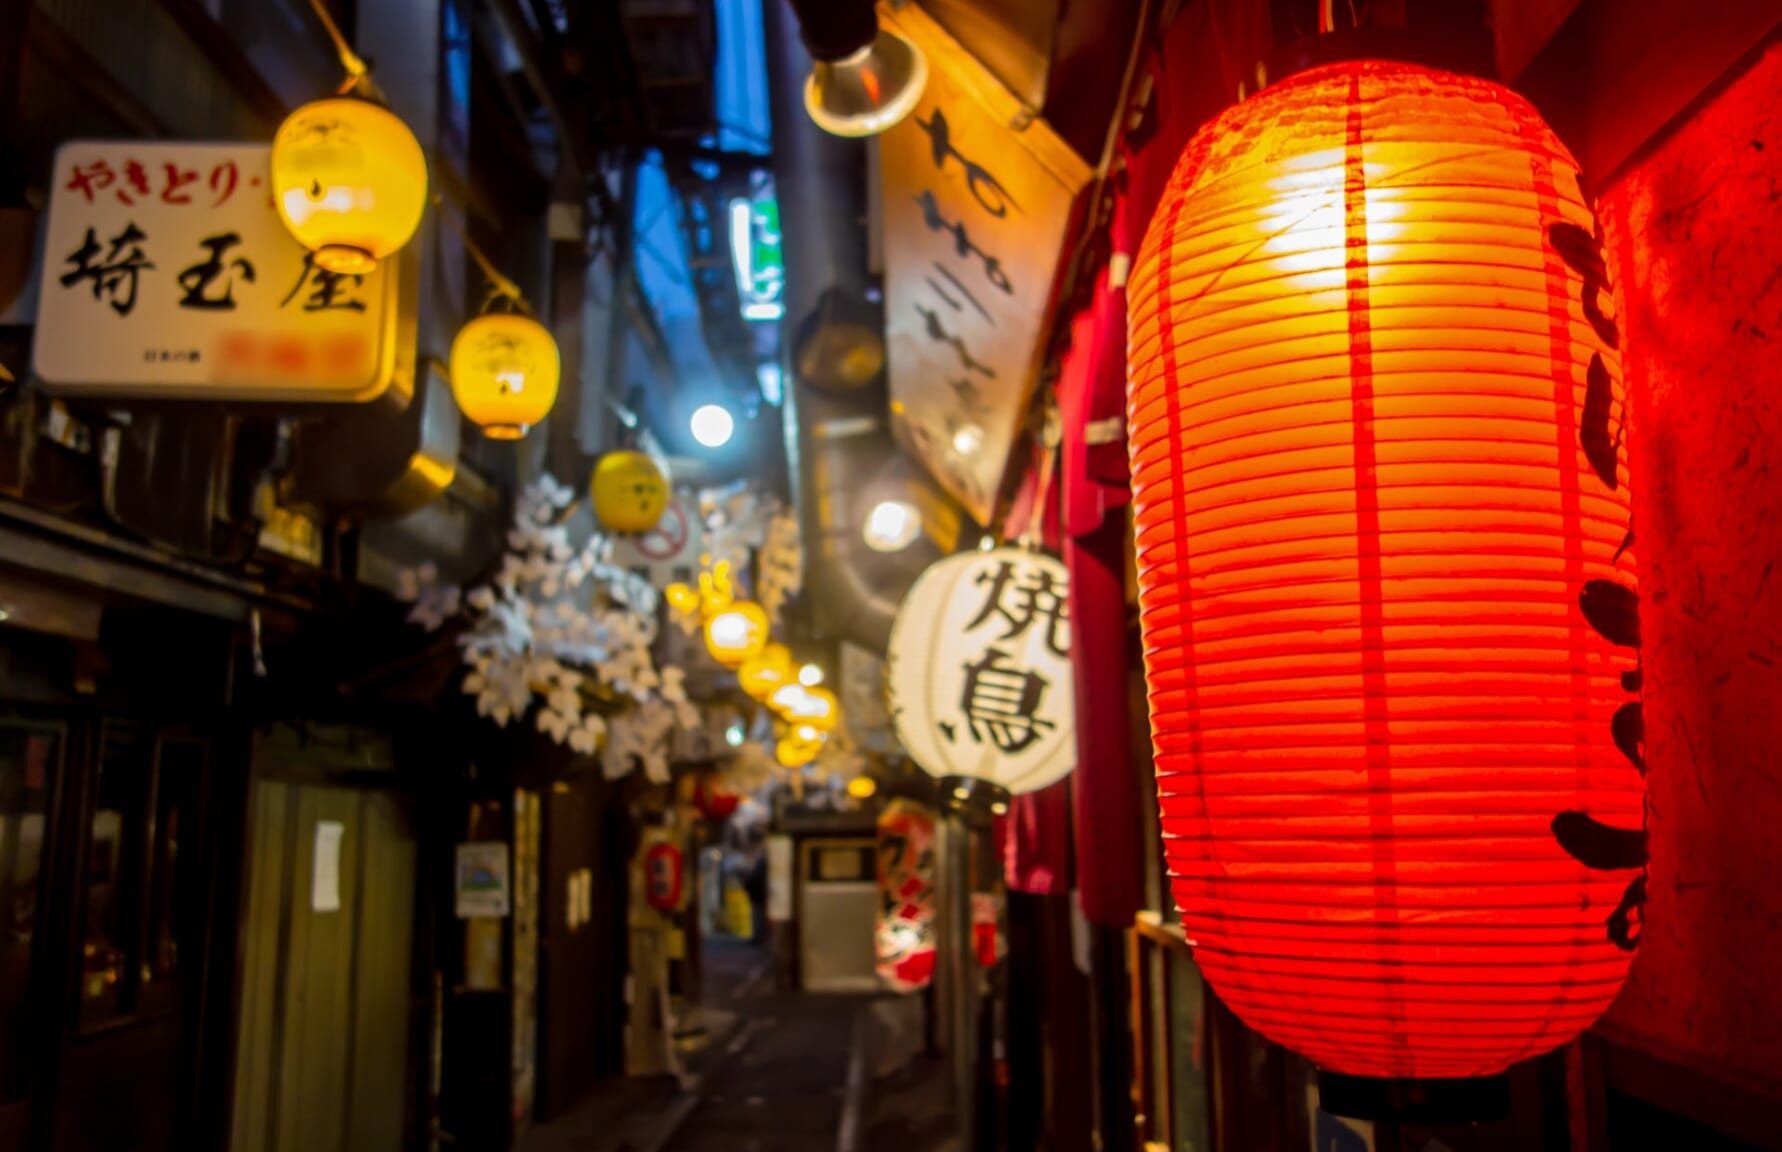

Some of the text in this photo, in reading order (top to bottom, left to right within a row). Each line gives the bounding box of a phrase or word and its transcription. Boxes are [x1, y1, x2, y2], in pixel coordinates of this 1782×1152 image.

[60, 221, 367, 317] 埼玉屋
[939, 561, 1070, 757] 焼鳥
